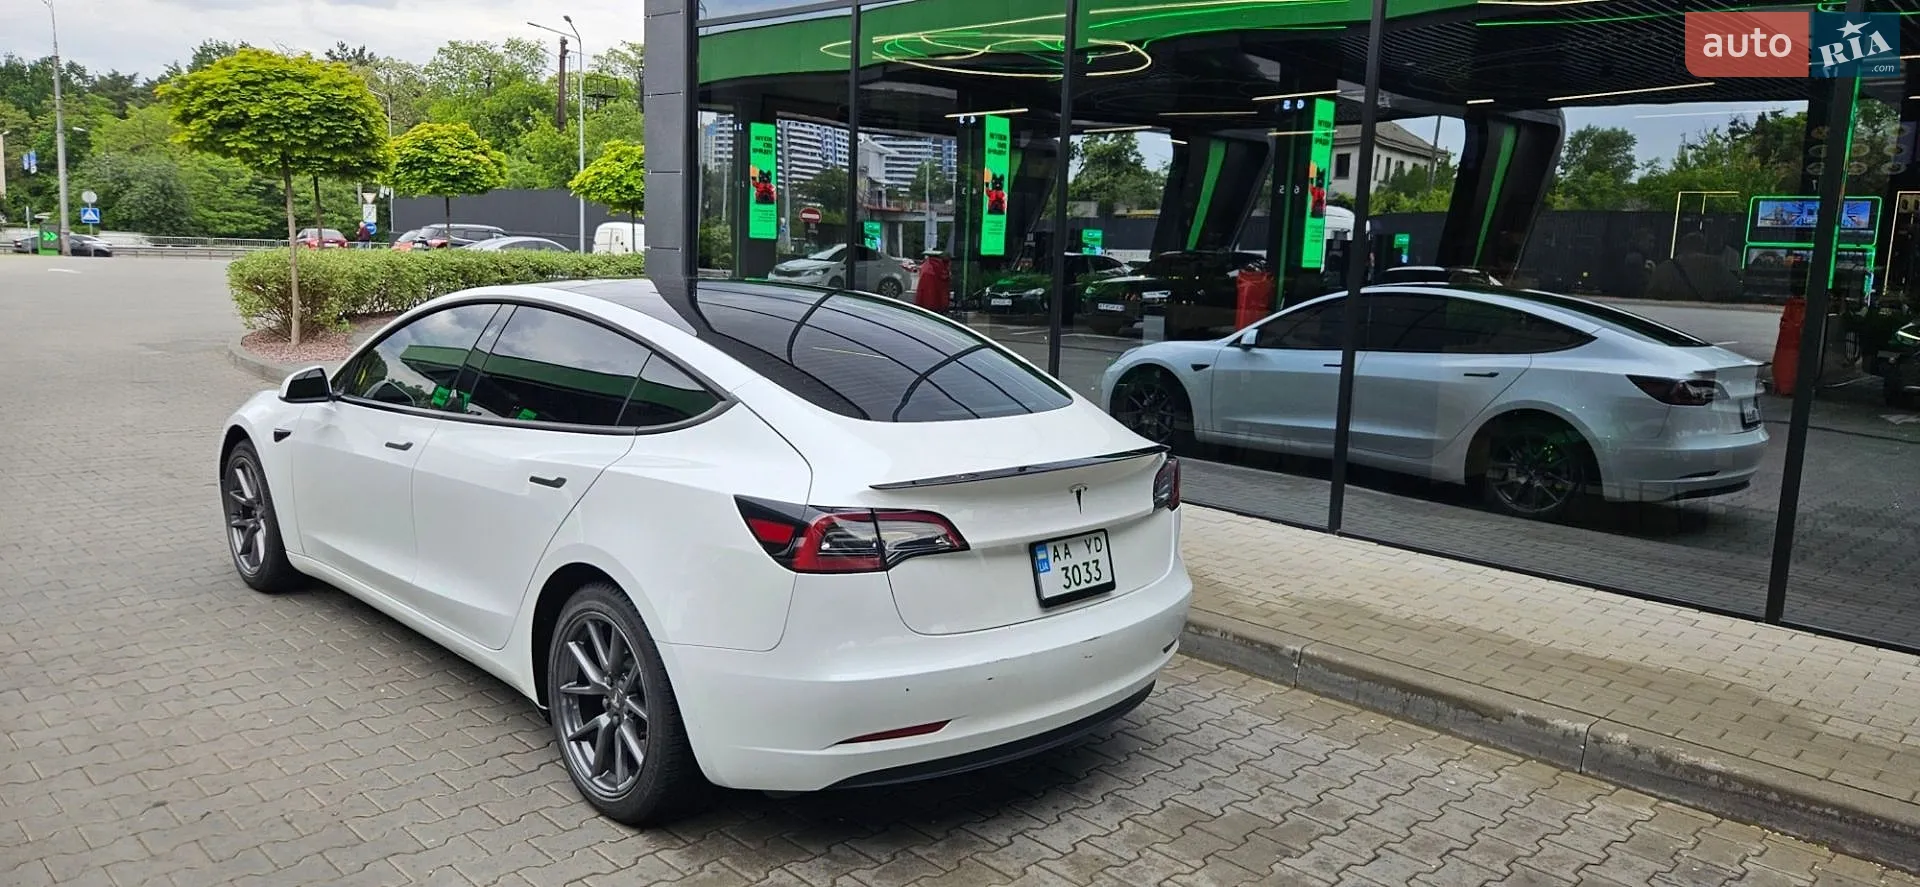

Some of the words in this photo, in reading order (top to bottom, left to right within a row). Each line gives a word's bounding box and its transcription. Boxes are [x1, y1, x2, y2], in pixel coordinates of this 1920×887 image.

[1052, 543, 1072, 563] AA
[1084, 536, 1103, 555] YD
[1061, 559, 1102, 590] 3033
